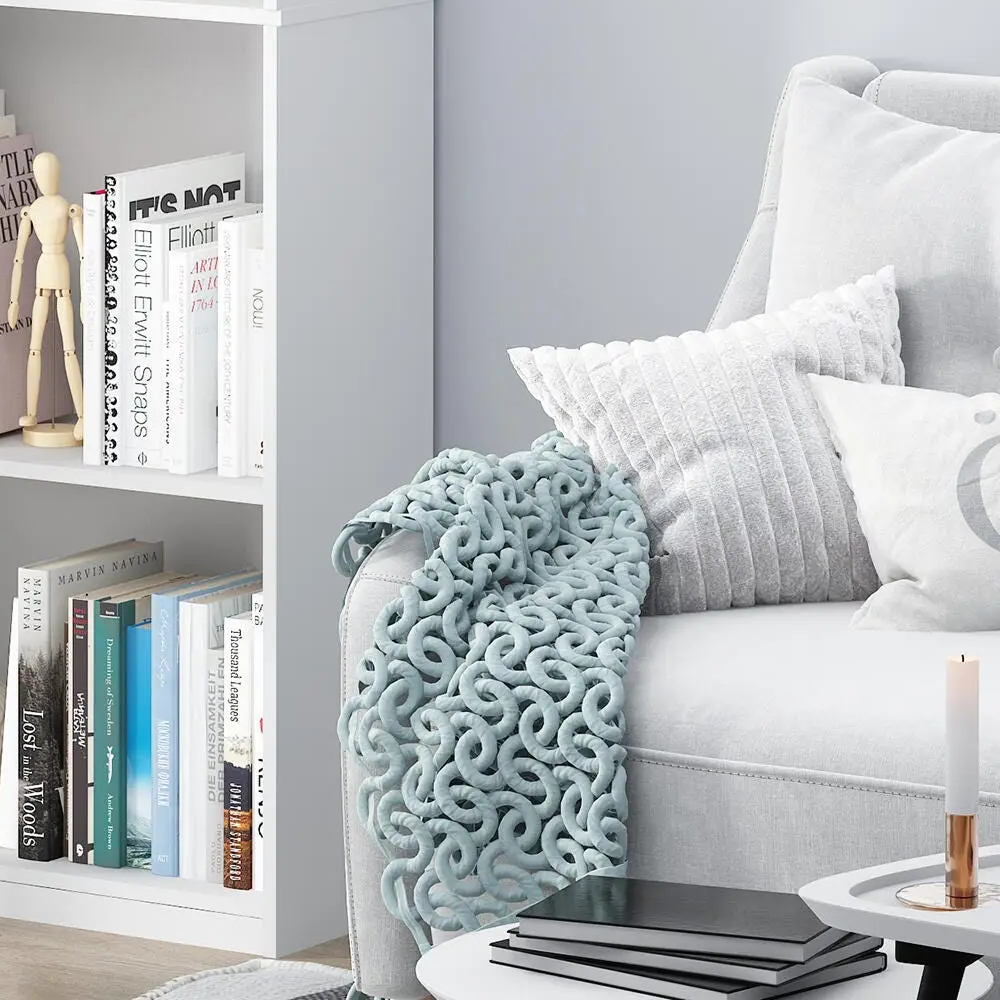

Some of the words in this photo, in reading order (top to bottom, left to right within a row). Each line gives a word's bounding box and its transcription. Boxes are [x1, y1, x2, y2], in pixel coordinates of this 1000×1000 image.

[128, 192, 178, 222] IT'S
[184, 179, 242, 207] NOT
[134, 228, 153, 288] Elliott
[134, 295, 153, 358] Erwitt
[133, 364, 153, 439] Snaps
[57, 565, 105, 586] MARVIN
[111, 551, 158, 572] NAVINA
[23, 576, 31, 631] NAVINA
[33, 577, 42, 633] MARVIN
[105, 638, 114, 684] Dreaming
[230, 628, 243, 679] Thousand
[106, 686, 114, 698] of
[227, 681, 241, 723] Leagues
[22, 707, 44, 752] Lost
[105, 698, 114, 736] Sweden
[207, 671, 216, 771] EINSAMKEIT
[22, 755, 32, 766] in
[22, 767, 32, 781] the
[208, 774, 216, 802] DIE
[228, 782, 242, 828] JONATHAN
[22, 781, 45, 847] Woods
[229, 831, 241, 881] STANDFORD
